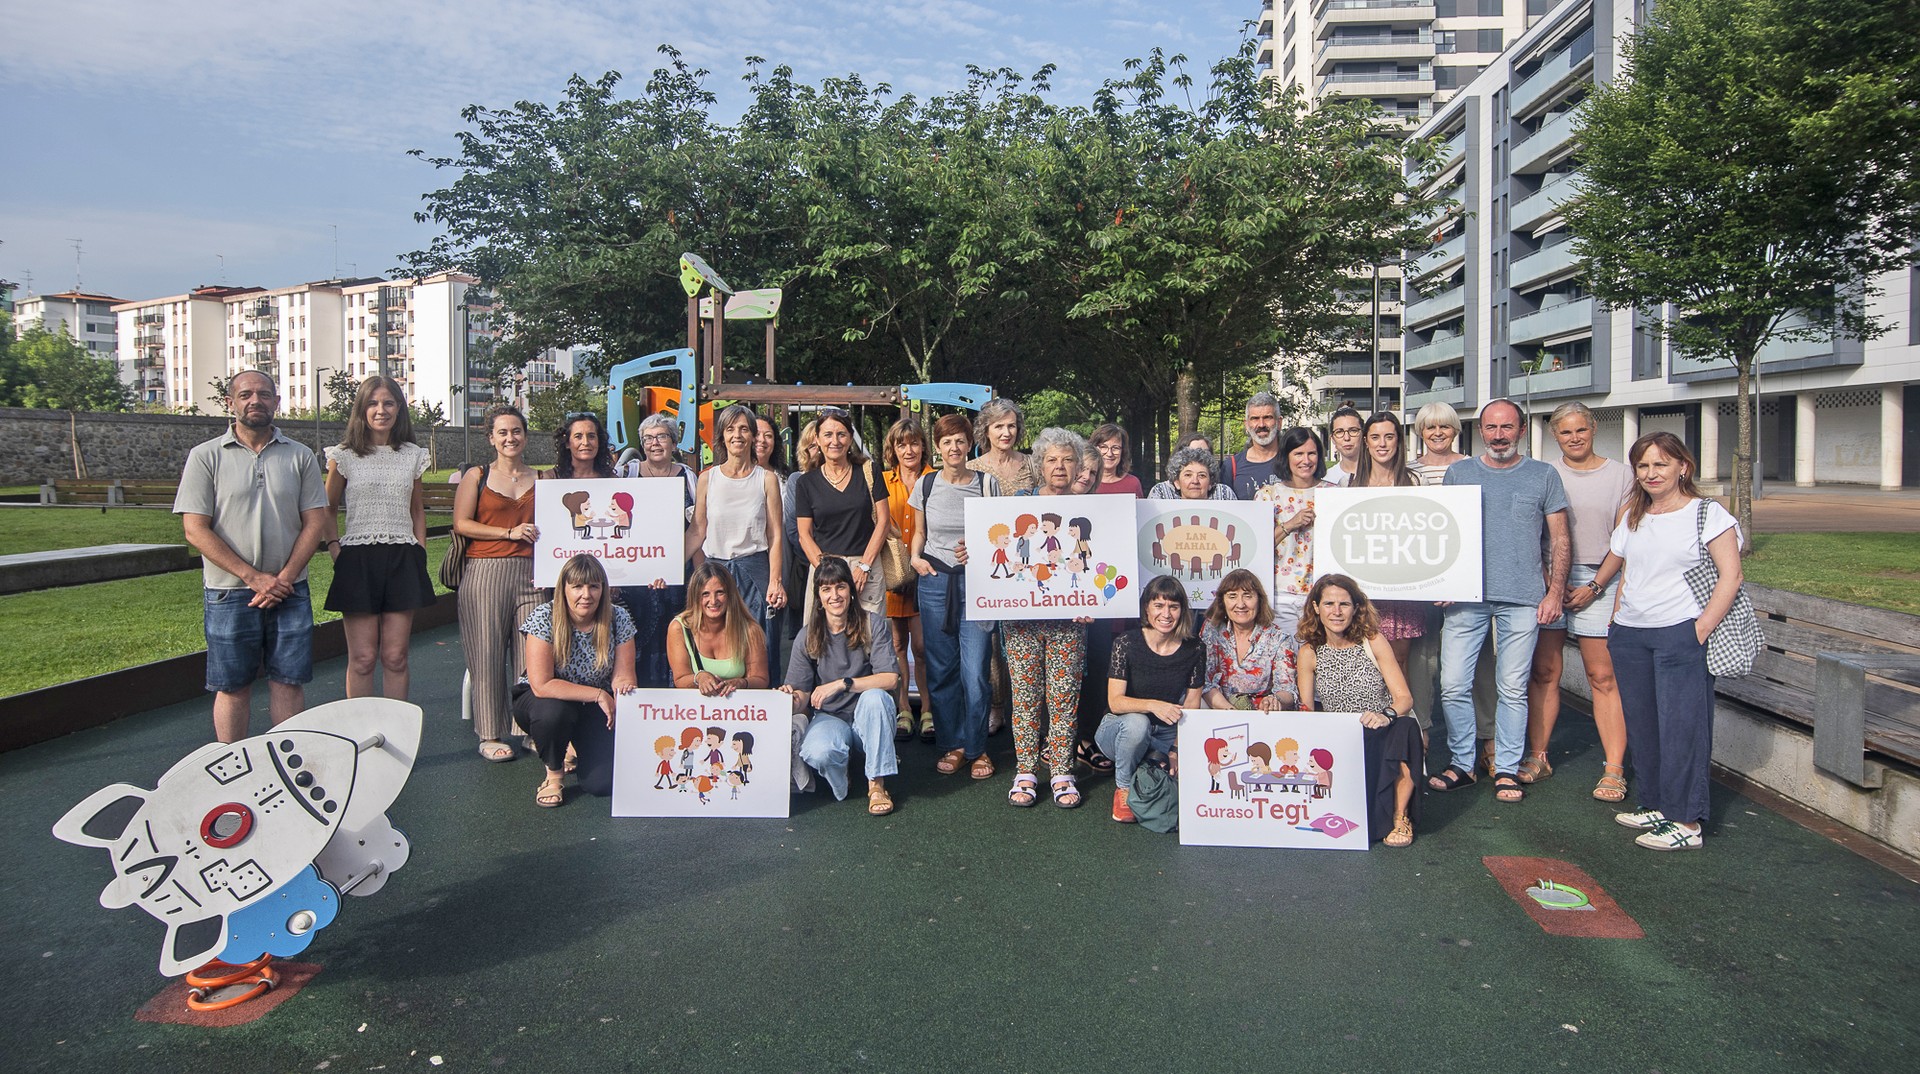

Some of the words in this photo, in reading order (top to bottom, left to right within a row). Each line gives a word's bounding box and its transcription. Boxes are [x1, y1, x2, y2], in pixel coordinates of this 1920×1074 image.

[1342, 512, 1449, 531] GURASO
[1186, 532, 1207, 540] LAN
[1175, 542, 1218, 551] MAHAIA
[1342, 534, 1449, 566] LEKU
[638, 703, 698, 721] Truke
[700, 704, 768, 722] Landia
